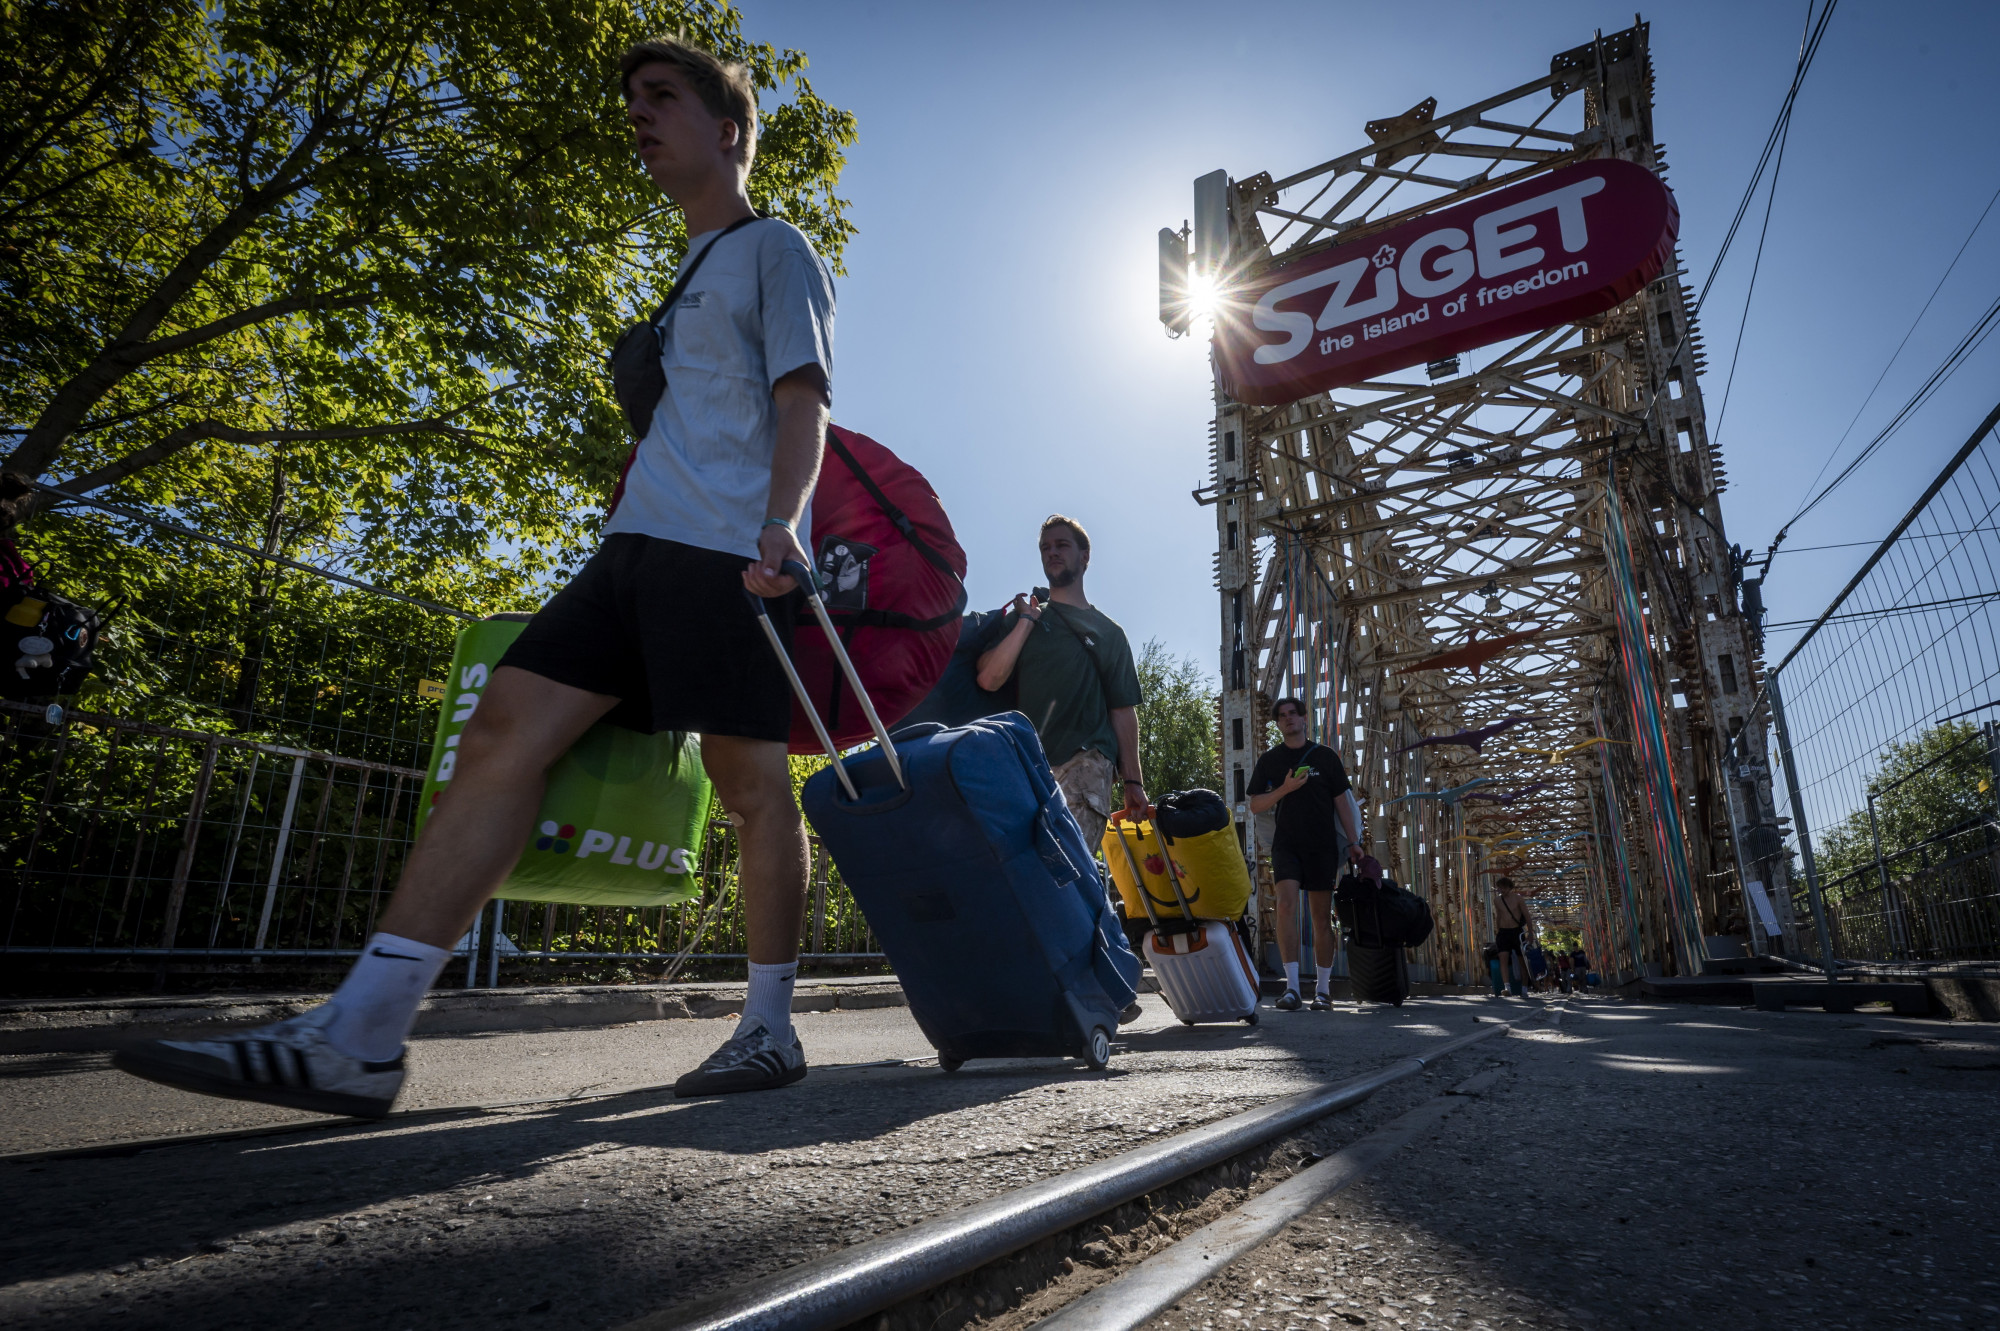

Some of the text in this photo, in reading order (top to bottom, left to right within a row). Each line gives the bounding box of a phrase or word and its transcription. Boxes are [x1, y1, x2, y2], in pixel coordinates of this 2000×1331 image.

[1319, 260, 1589, 356] the island of freedom
[575, 828, 689, 874] PLUS
